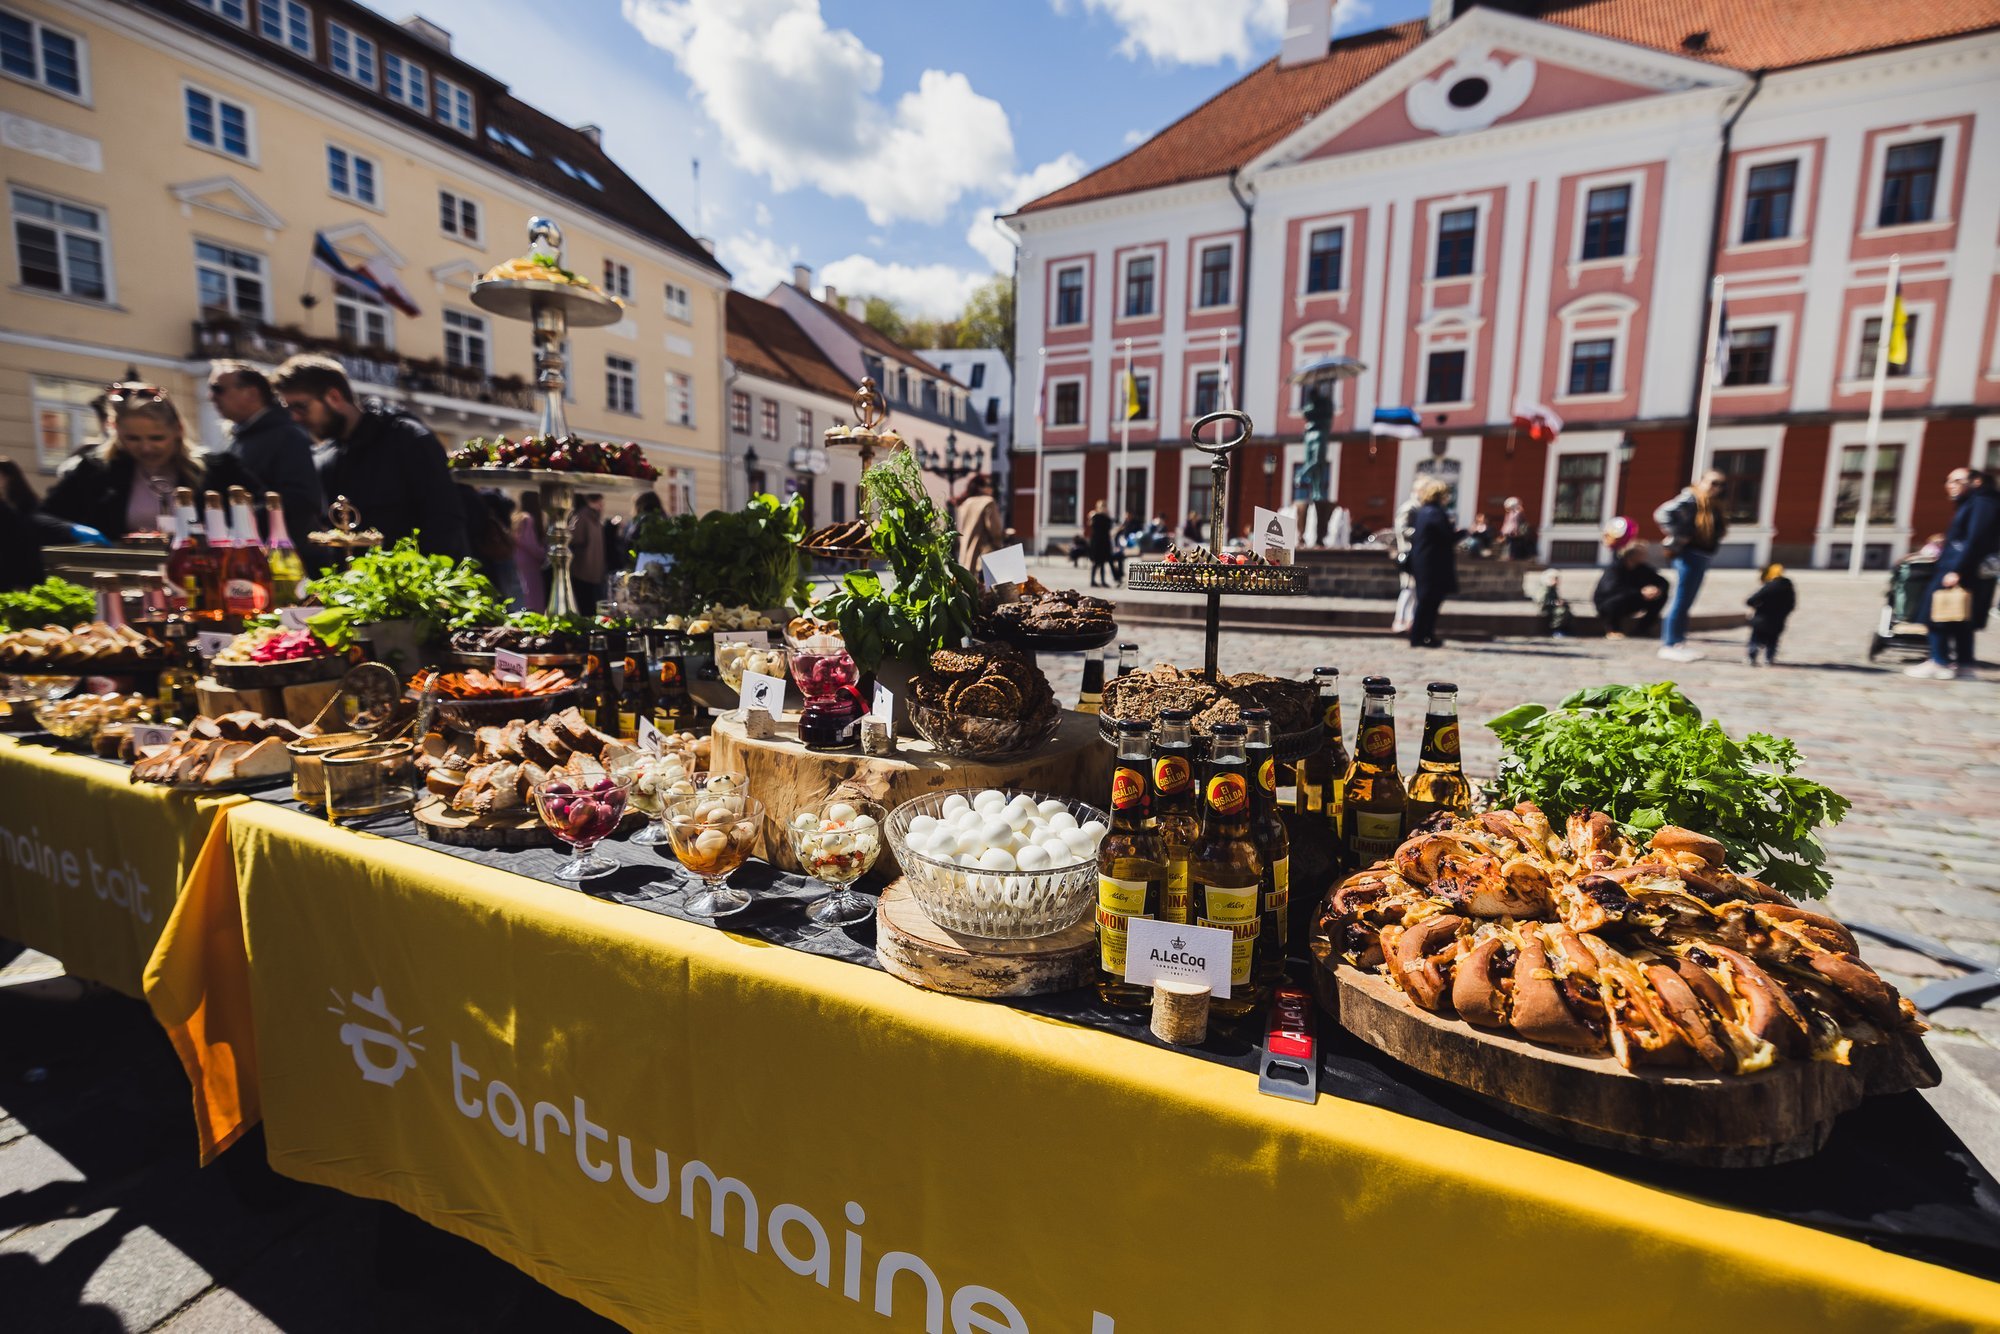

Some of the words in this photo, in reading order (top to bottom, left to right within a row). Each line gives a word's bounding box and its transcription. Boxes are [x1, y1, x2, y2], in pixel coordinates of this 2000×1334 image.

[1213, 789, 1243, 807] SISALDA
[1096, 908, 1128, 931] LIMON
[1150, 948, 1206, 971] A.LeCoq
[449, 1039, 1030, 1334] tartumaine
